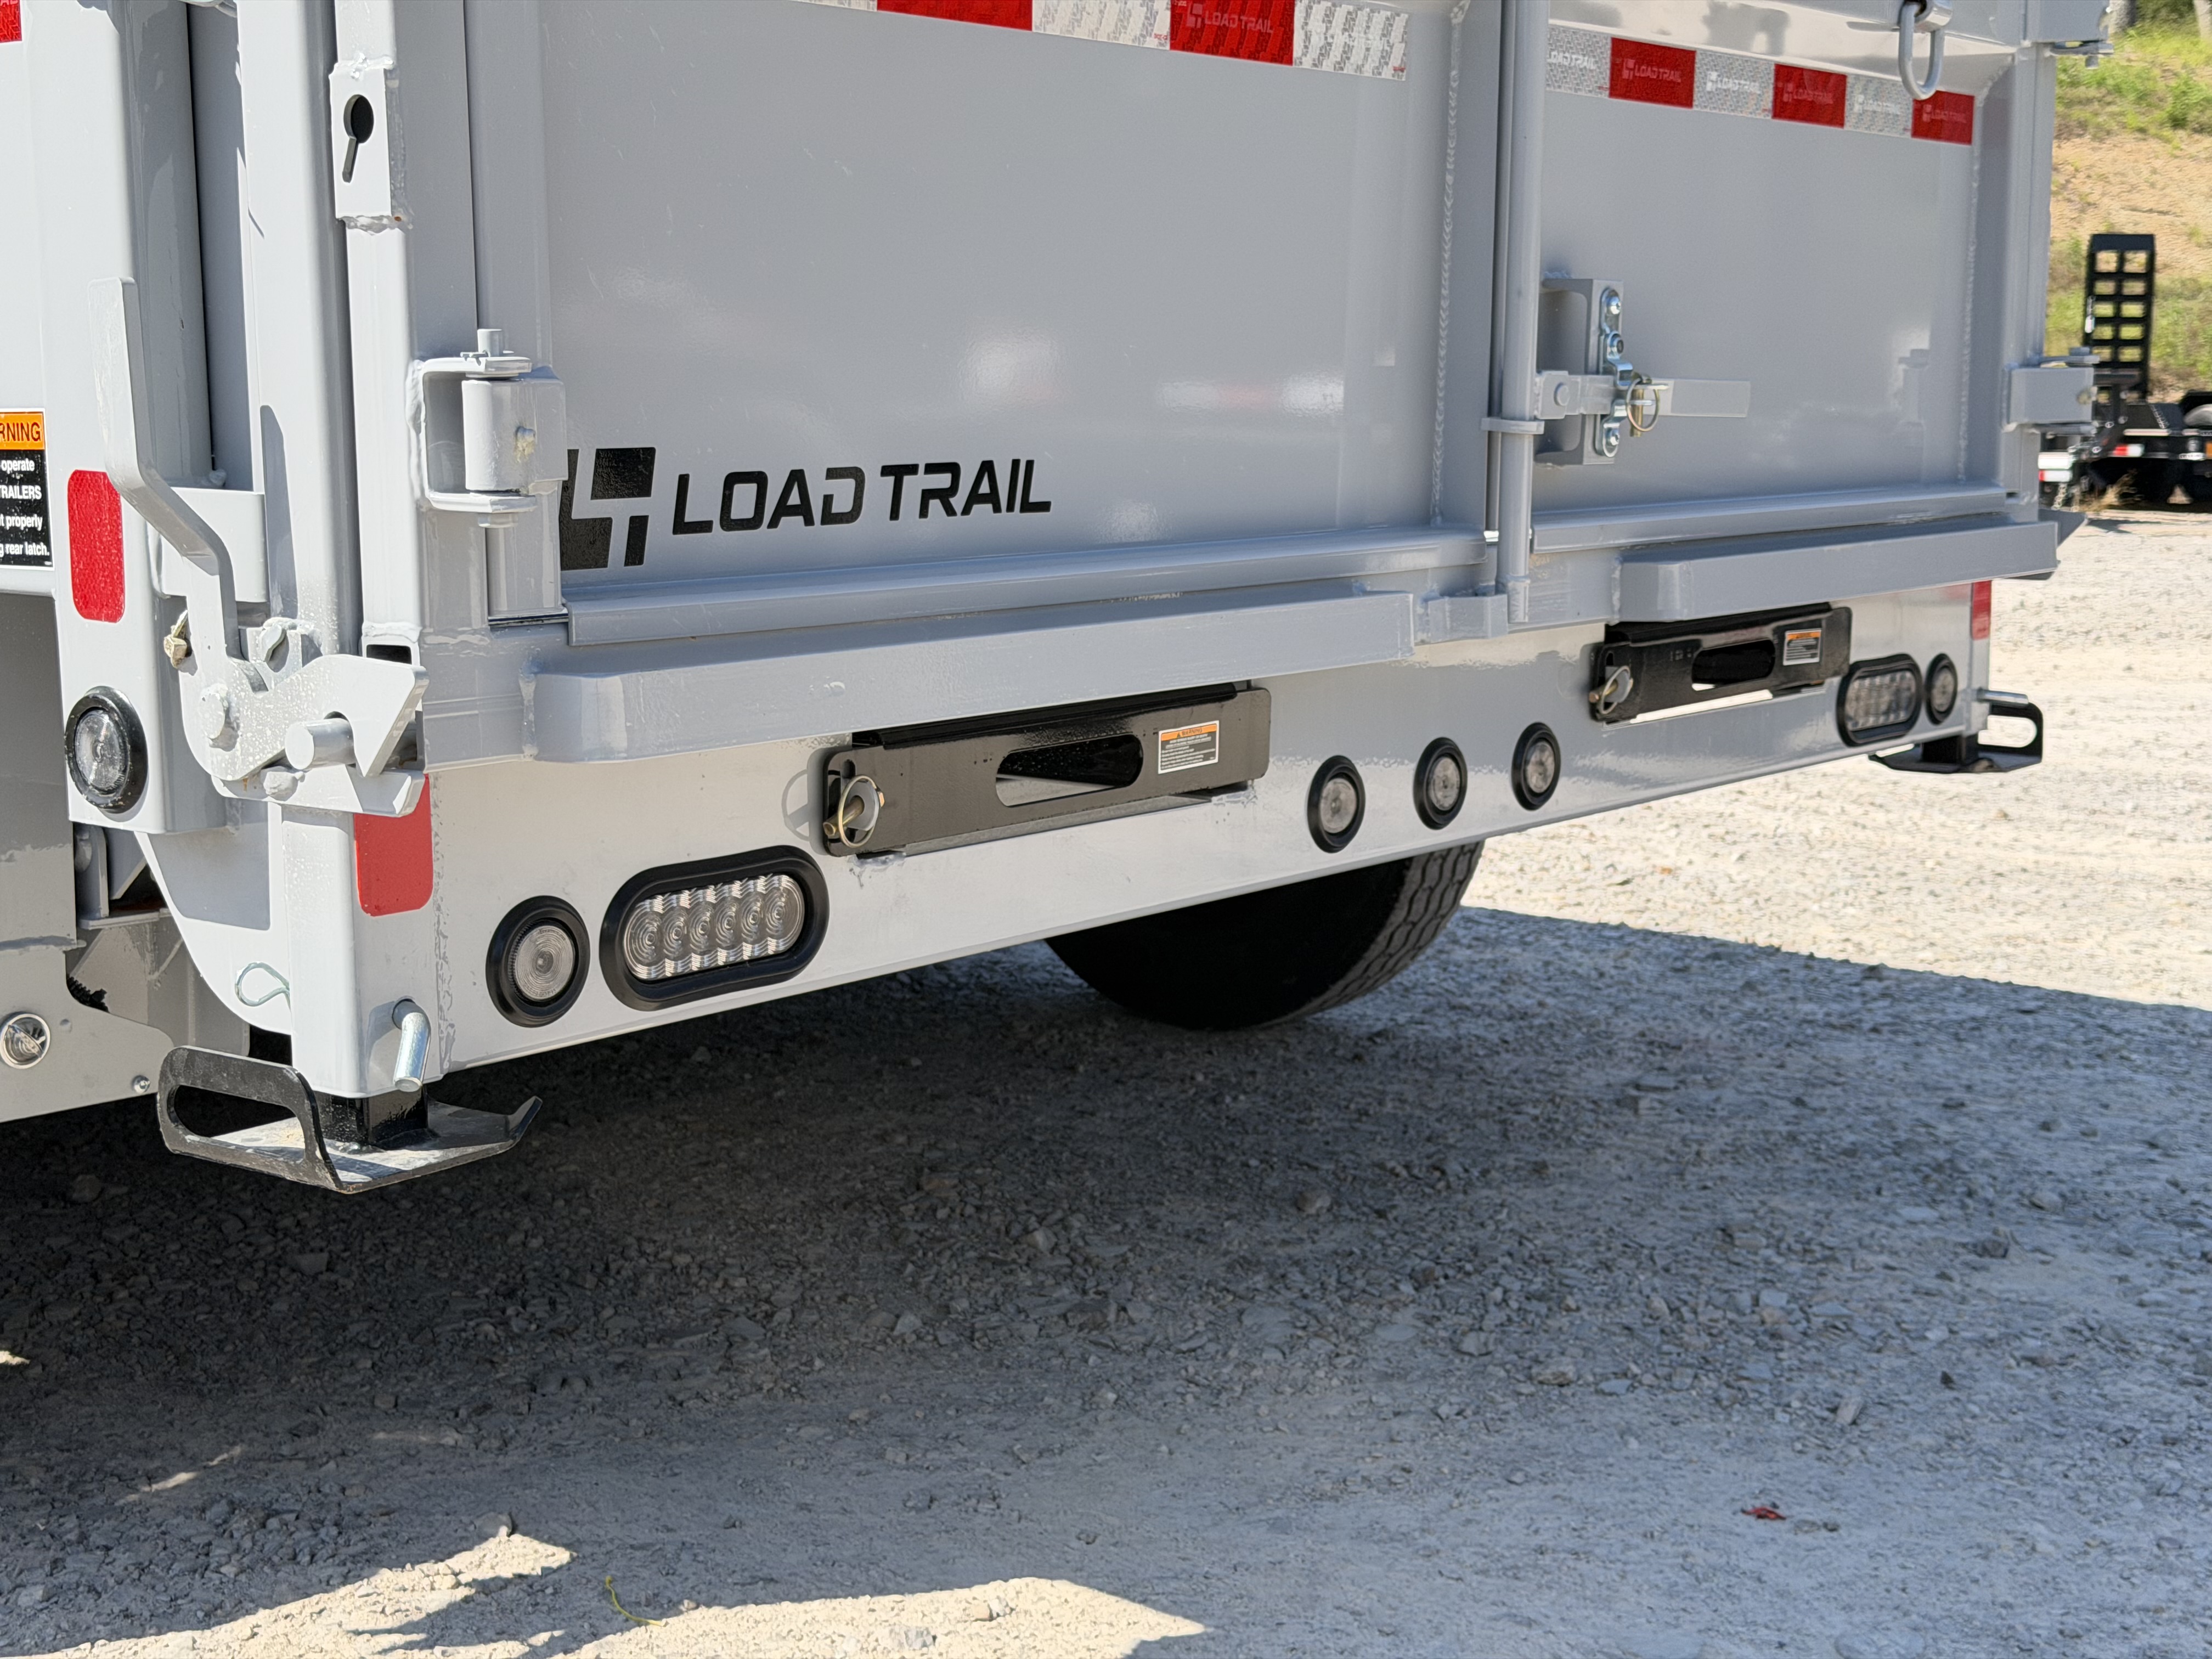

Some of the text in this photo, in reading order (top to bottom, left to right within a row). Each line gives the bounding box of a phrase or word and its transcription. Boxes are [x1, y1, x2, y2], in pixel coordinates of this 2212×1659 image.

[1205, 10, 1273, 33] LOAD TRAIL
[1635, 64, 1657, 79] LOAD
[1, 458, 35, 475] operate
[672, 458, 1052, 535] LOAD TRAIL
[5, 514, 43, 531] properly
[5, 543, 23, 555] rear
[24, 541, 50, 556] latch.
